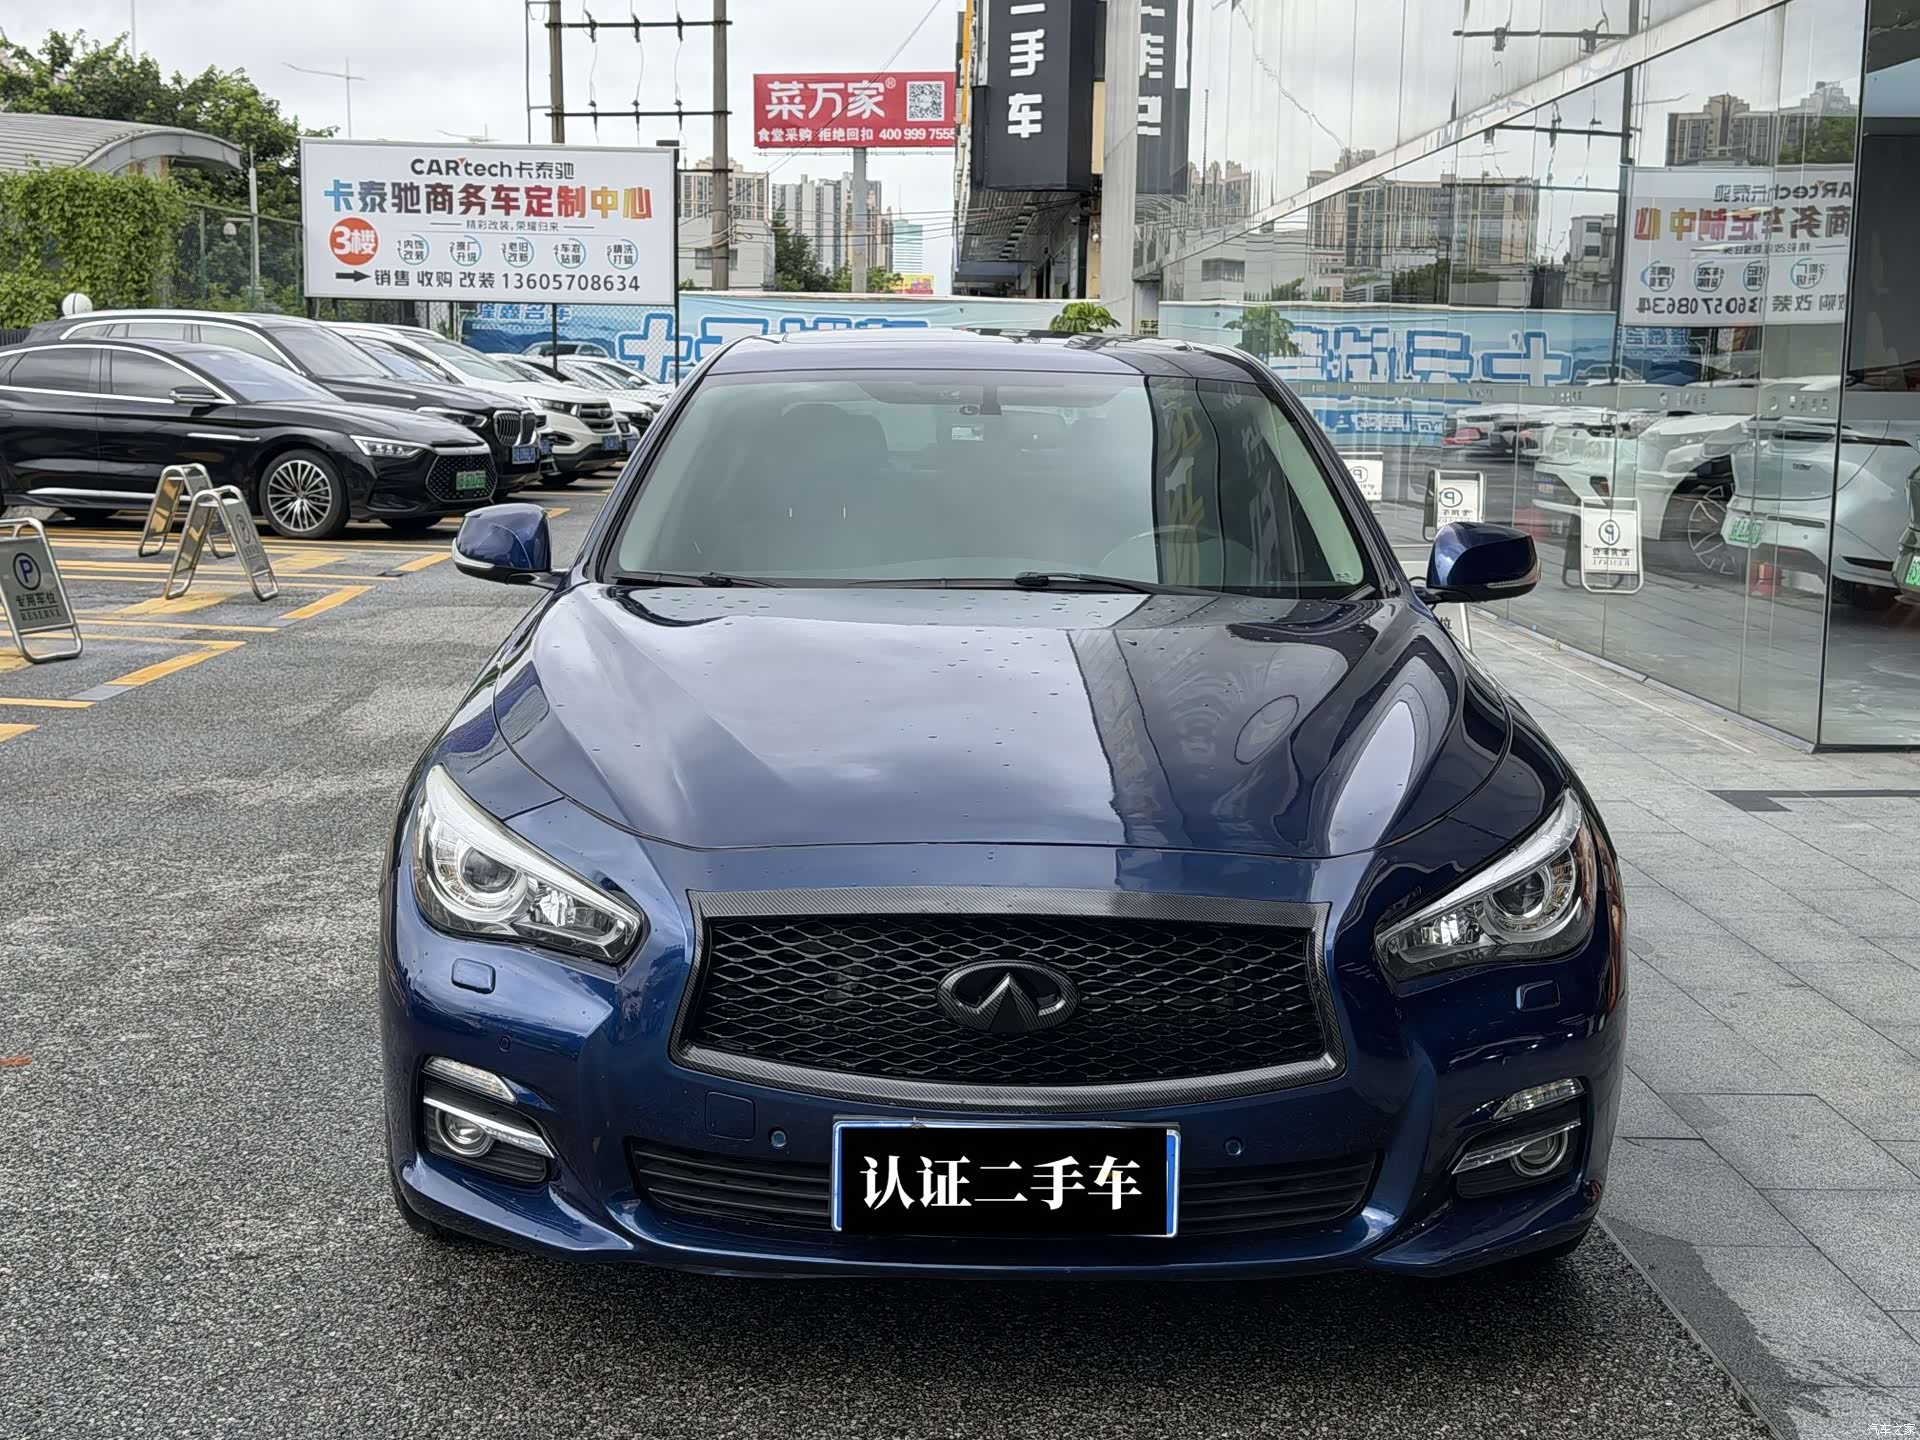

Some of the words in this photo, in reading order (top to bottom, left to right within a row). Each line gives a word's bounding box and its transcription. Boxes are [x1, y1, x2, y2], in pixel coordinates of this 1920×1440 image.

[757, 127, 813, 142] 食堂采购
[819, 127, 874, 142] 拒绝回扣
[879, 129, 901, 141] 400
[904, 129, 926, 141] 999
[324, 179, 652, 220] 卡泰驰商务车定制中心
[333, 226, 377, 255] 3楼
[374, 269, 410, 287] 销售
[417, 270, 453, 288] 收购
[459, 271, 495, 289] 改装
[501, 272, 641, 292] 13605708634
[19, 559, 33, 583] P
